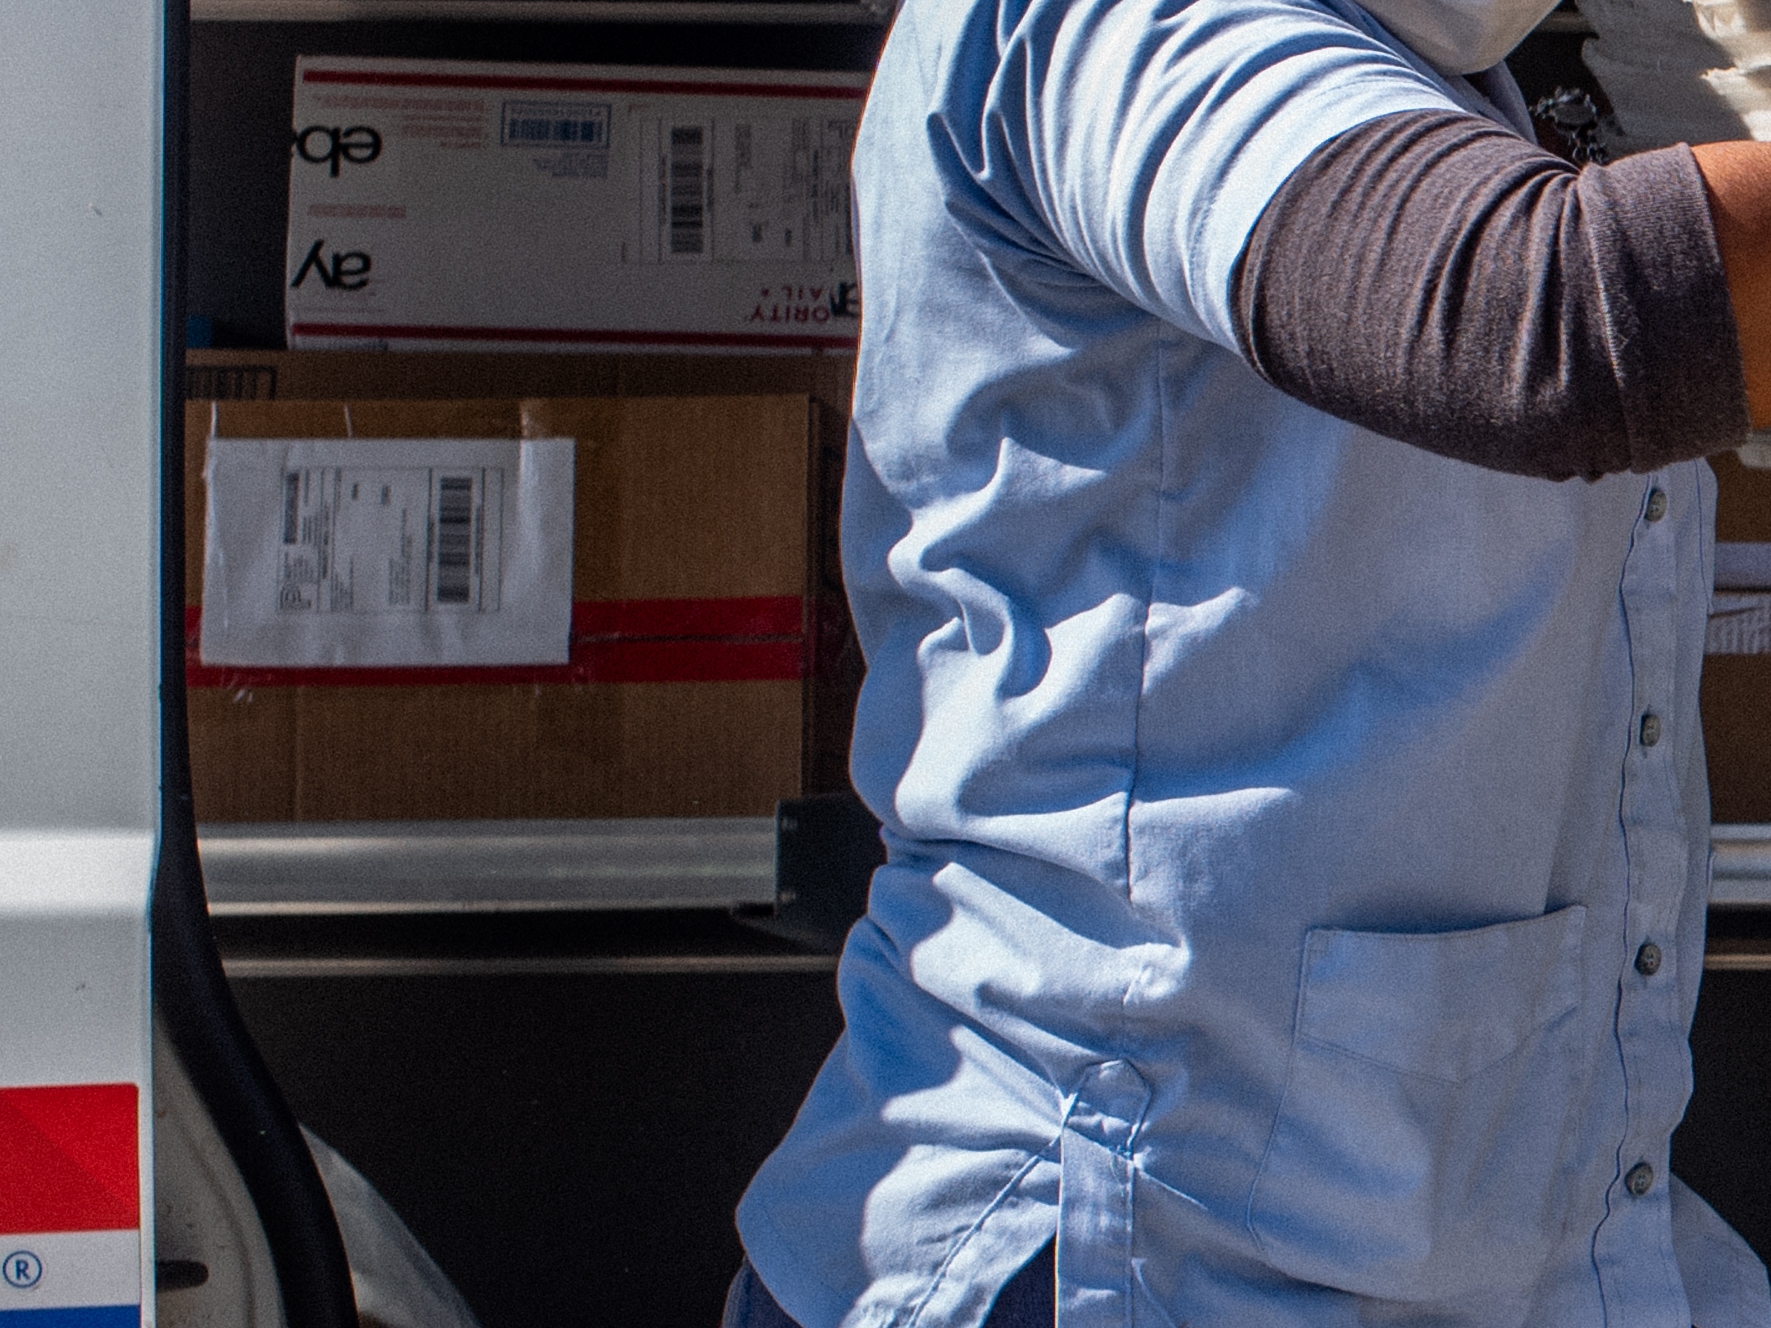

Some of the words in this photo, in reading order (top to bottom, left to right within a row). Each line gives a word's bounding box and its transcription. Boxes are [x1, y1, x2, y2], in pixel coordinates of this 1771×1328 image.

[296, 124, 383, 178] eb
[781, 283, 822, 301] AIL
[750, 304, 830, 323] ORITY
